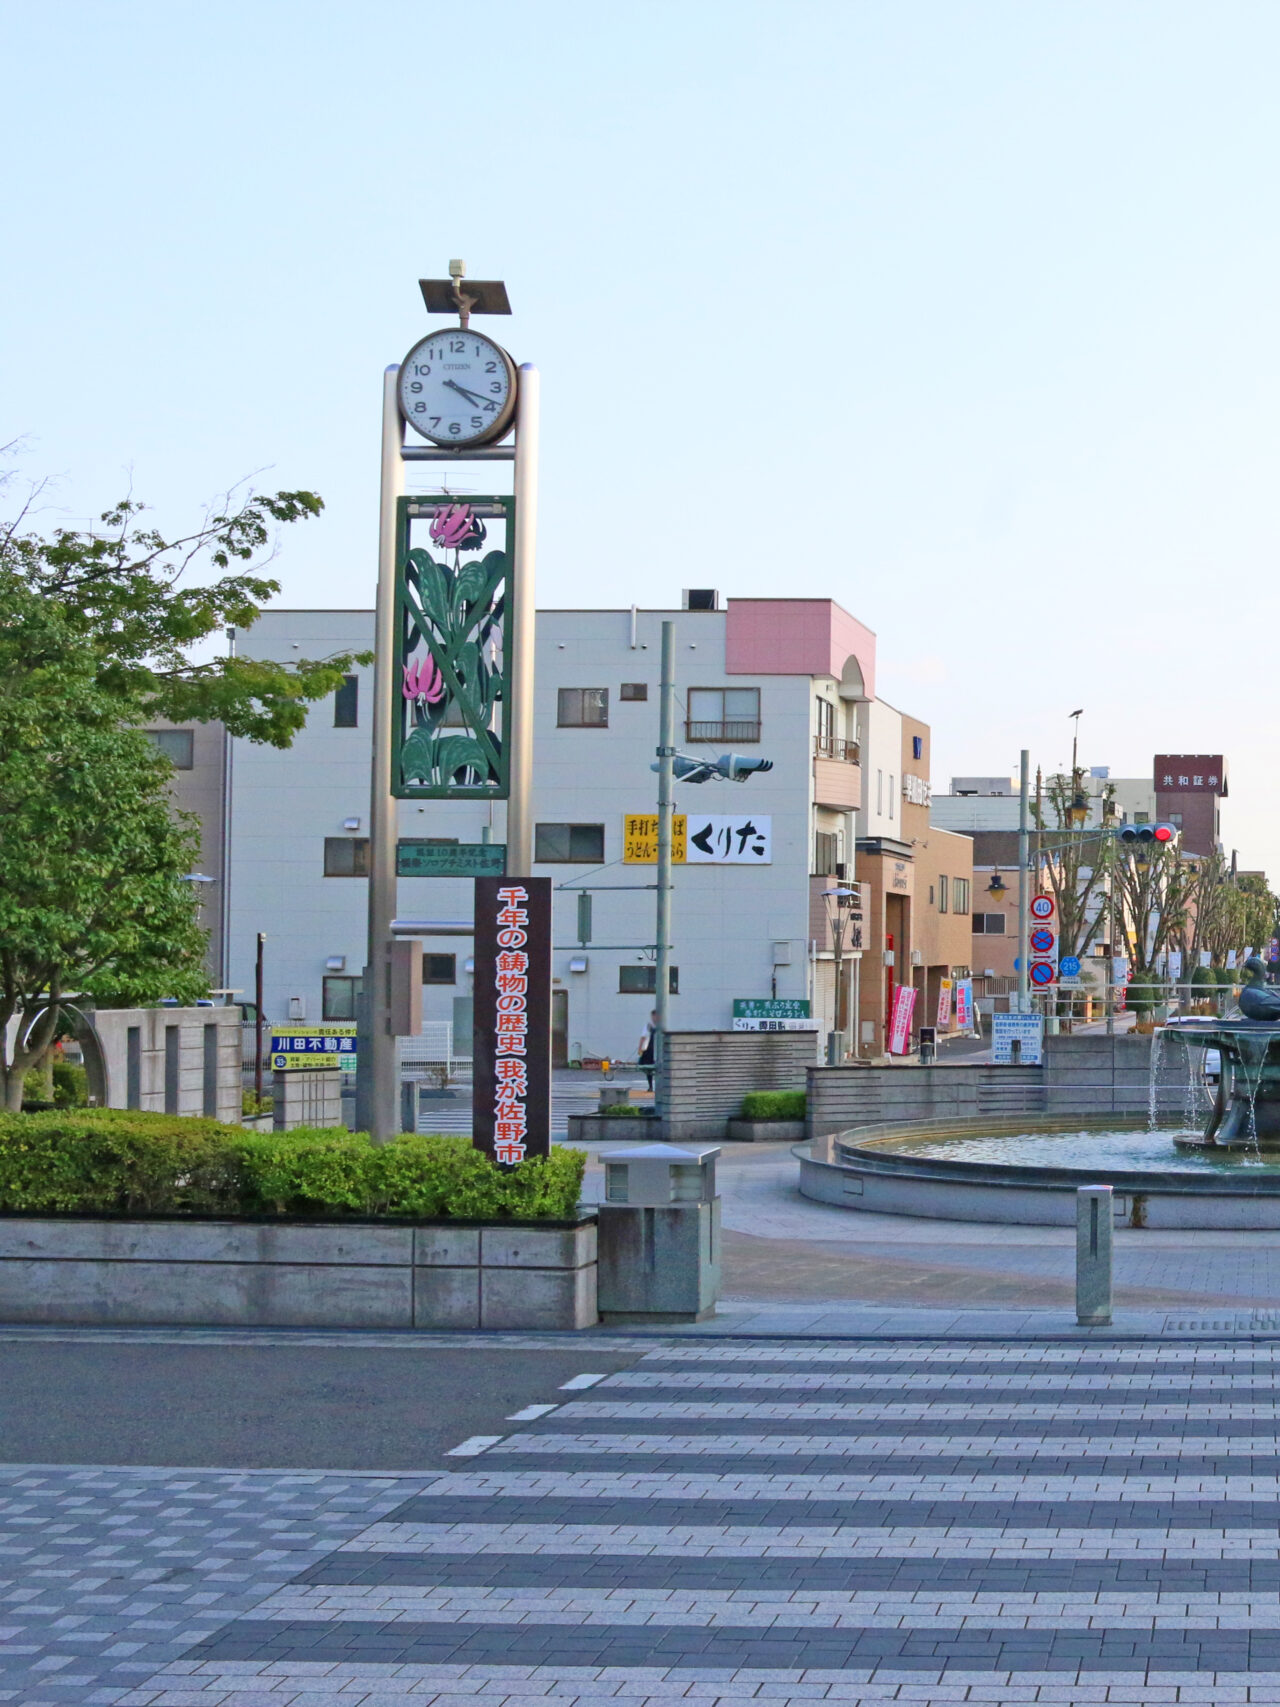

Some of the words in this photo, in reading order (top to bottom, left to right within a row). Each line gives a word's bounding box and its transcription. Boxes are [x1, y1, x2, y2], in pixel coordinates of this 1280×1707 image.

[449, 341, 465, 353] 12
[475, 346, 480, 357] 1
[429, 349, 443, 360] 11
[414, 365, 431, 376] 10
[484, 361, 497, 373] 2
[410, 382, 423, 393] 9
[489, 382, 502, 393] 3
[414, 402, 427, 413] 8
[482, 401, 497, 412] 4
[429, 417, 441, 429] 7
[470, 417, 483, 428] 5
[448, 423, 461, 435] 6
[1163, 775, 1218, 786] 共和証券
[627, 820, 685, 836] 手打ちば
[691, 821, 766, 858] くりた
[1036, 901, 1050, 913] 40
[497, 887, 528, 949] 千年の
[1064, 960, 1078, 971] 215
[495, 951, 528, 1056] 鋳物の歴史
[278, 1038, 352, 1050] 川田不動産
[494, 1058, 527, 1164] 我が佐野市
